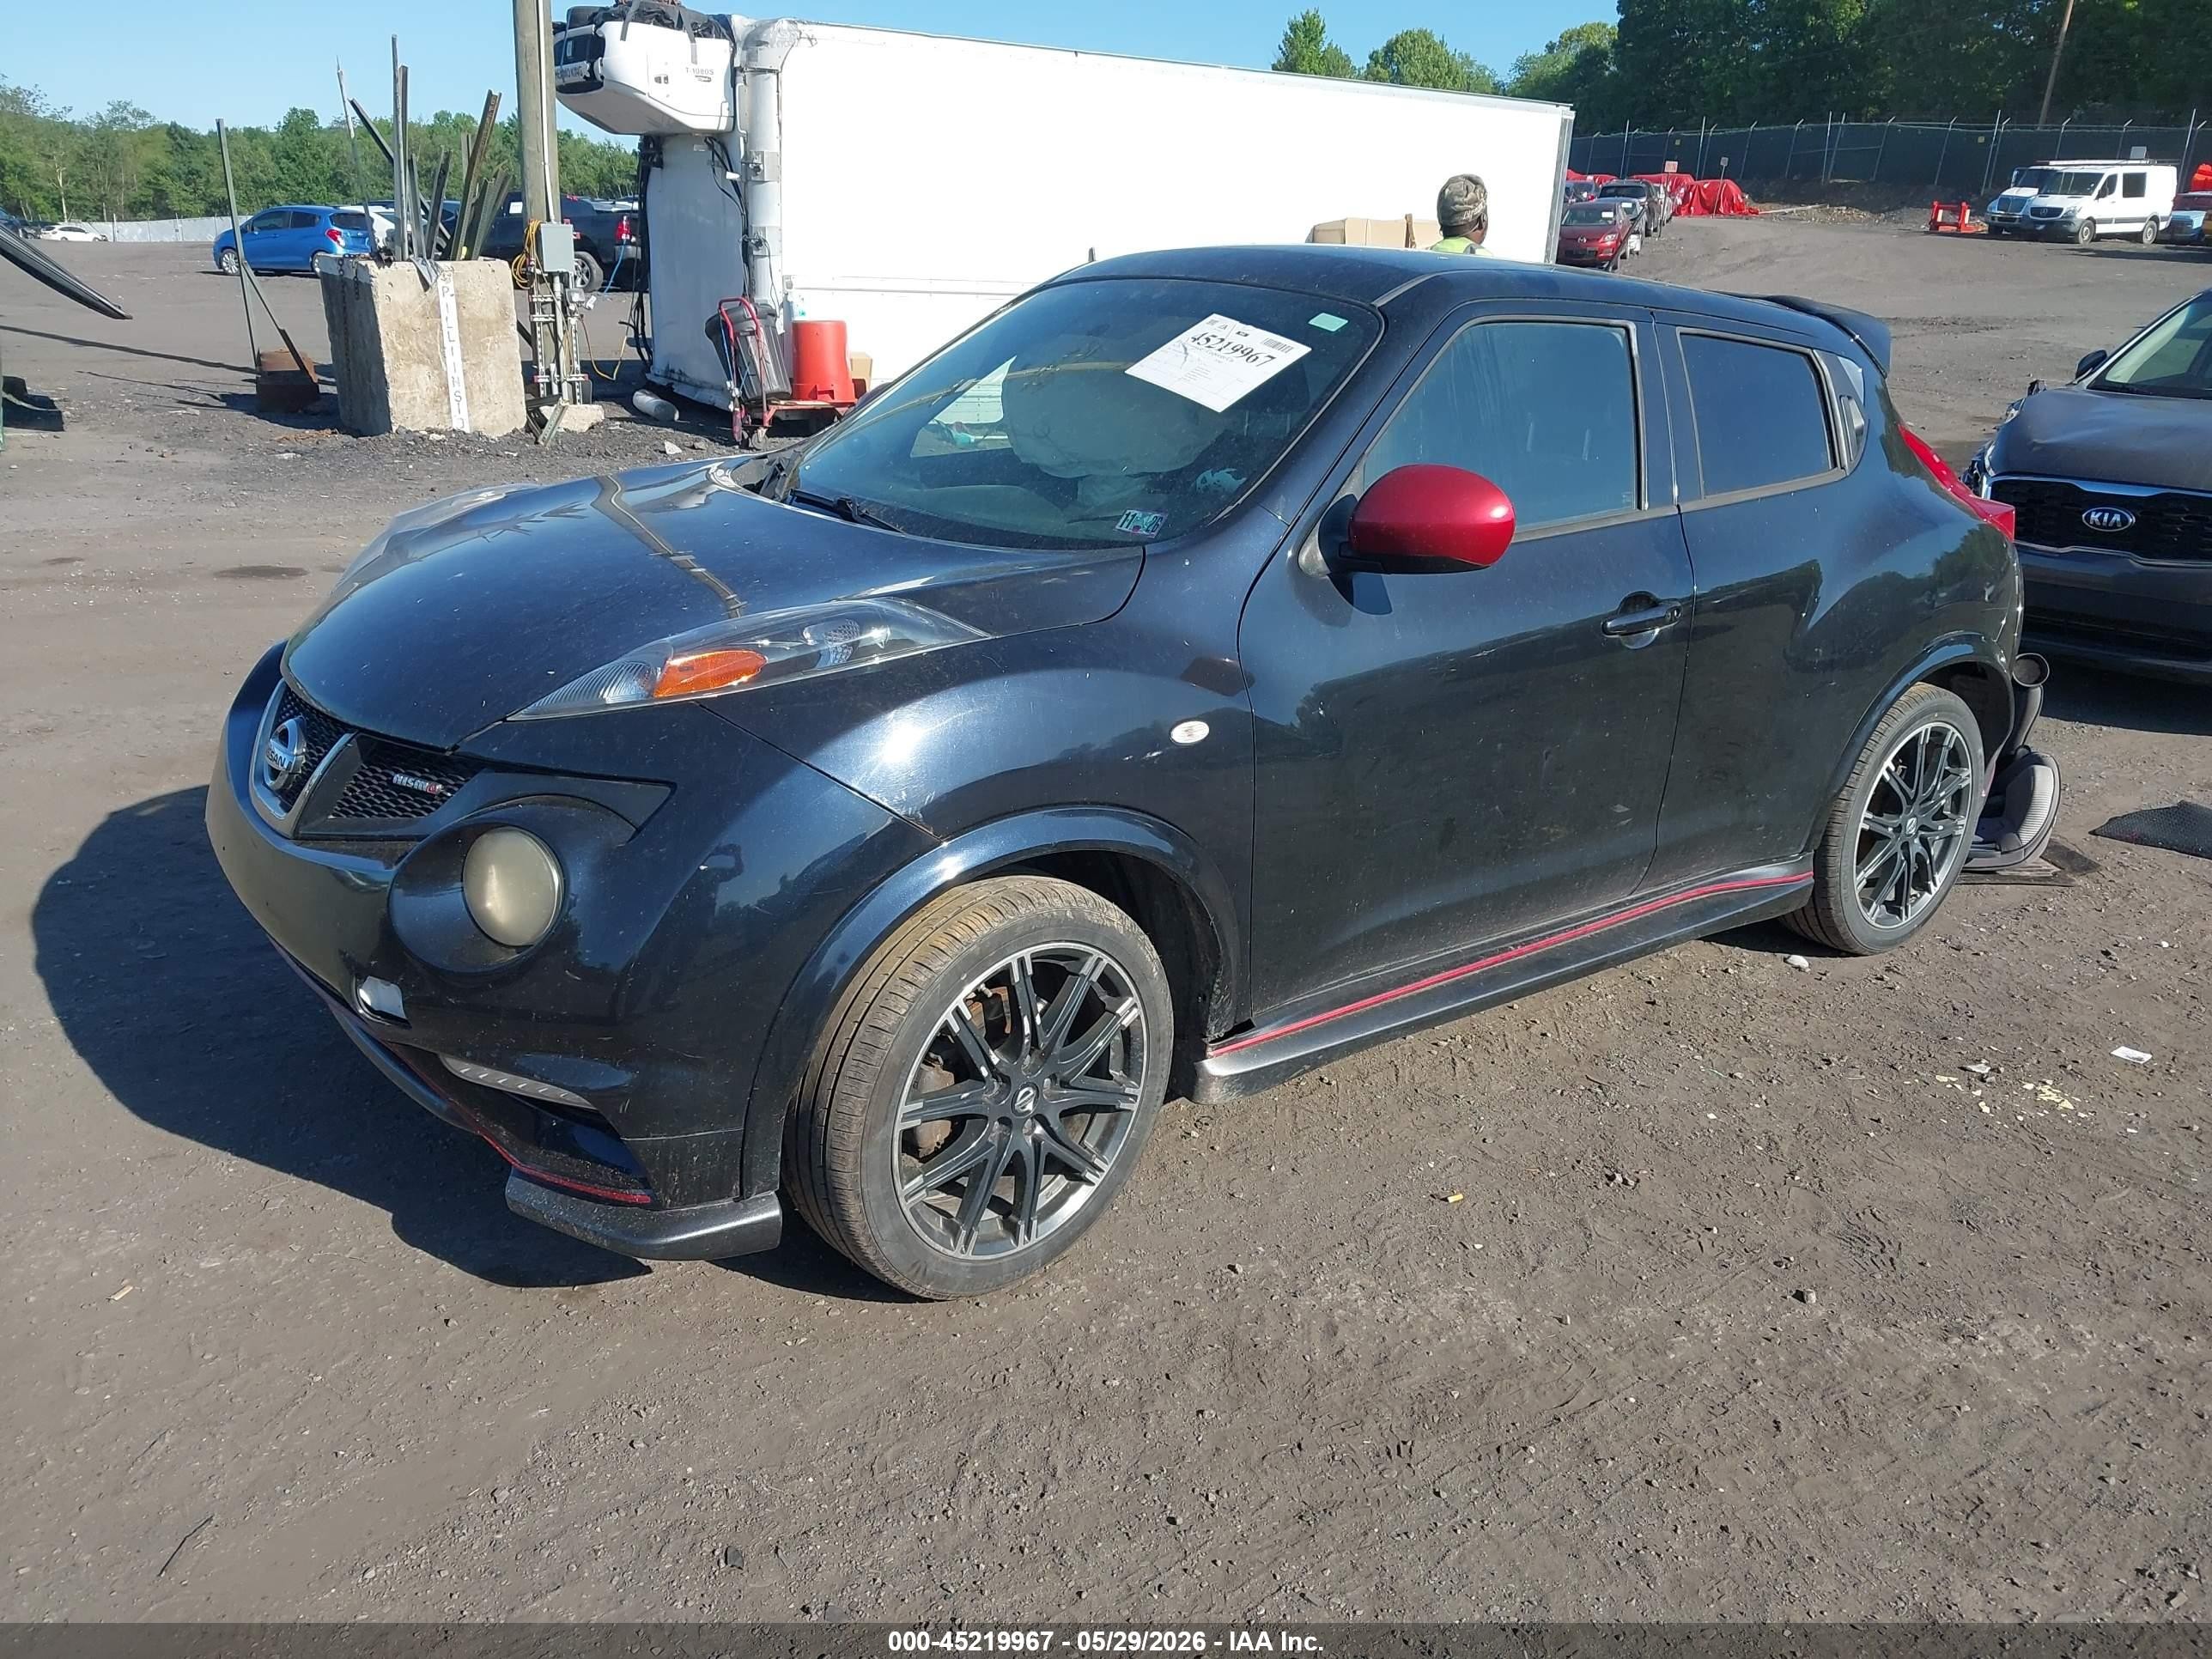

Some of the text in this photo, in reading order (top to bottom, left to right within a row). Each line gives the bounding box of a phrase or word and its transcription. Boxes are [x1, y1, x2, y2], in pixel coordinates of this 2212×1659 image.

[1190, 331, 1277, 368] 45219967
[1120, 511, 1164, 532] 11 26
[2089, 511, 2122, 527] KIA
